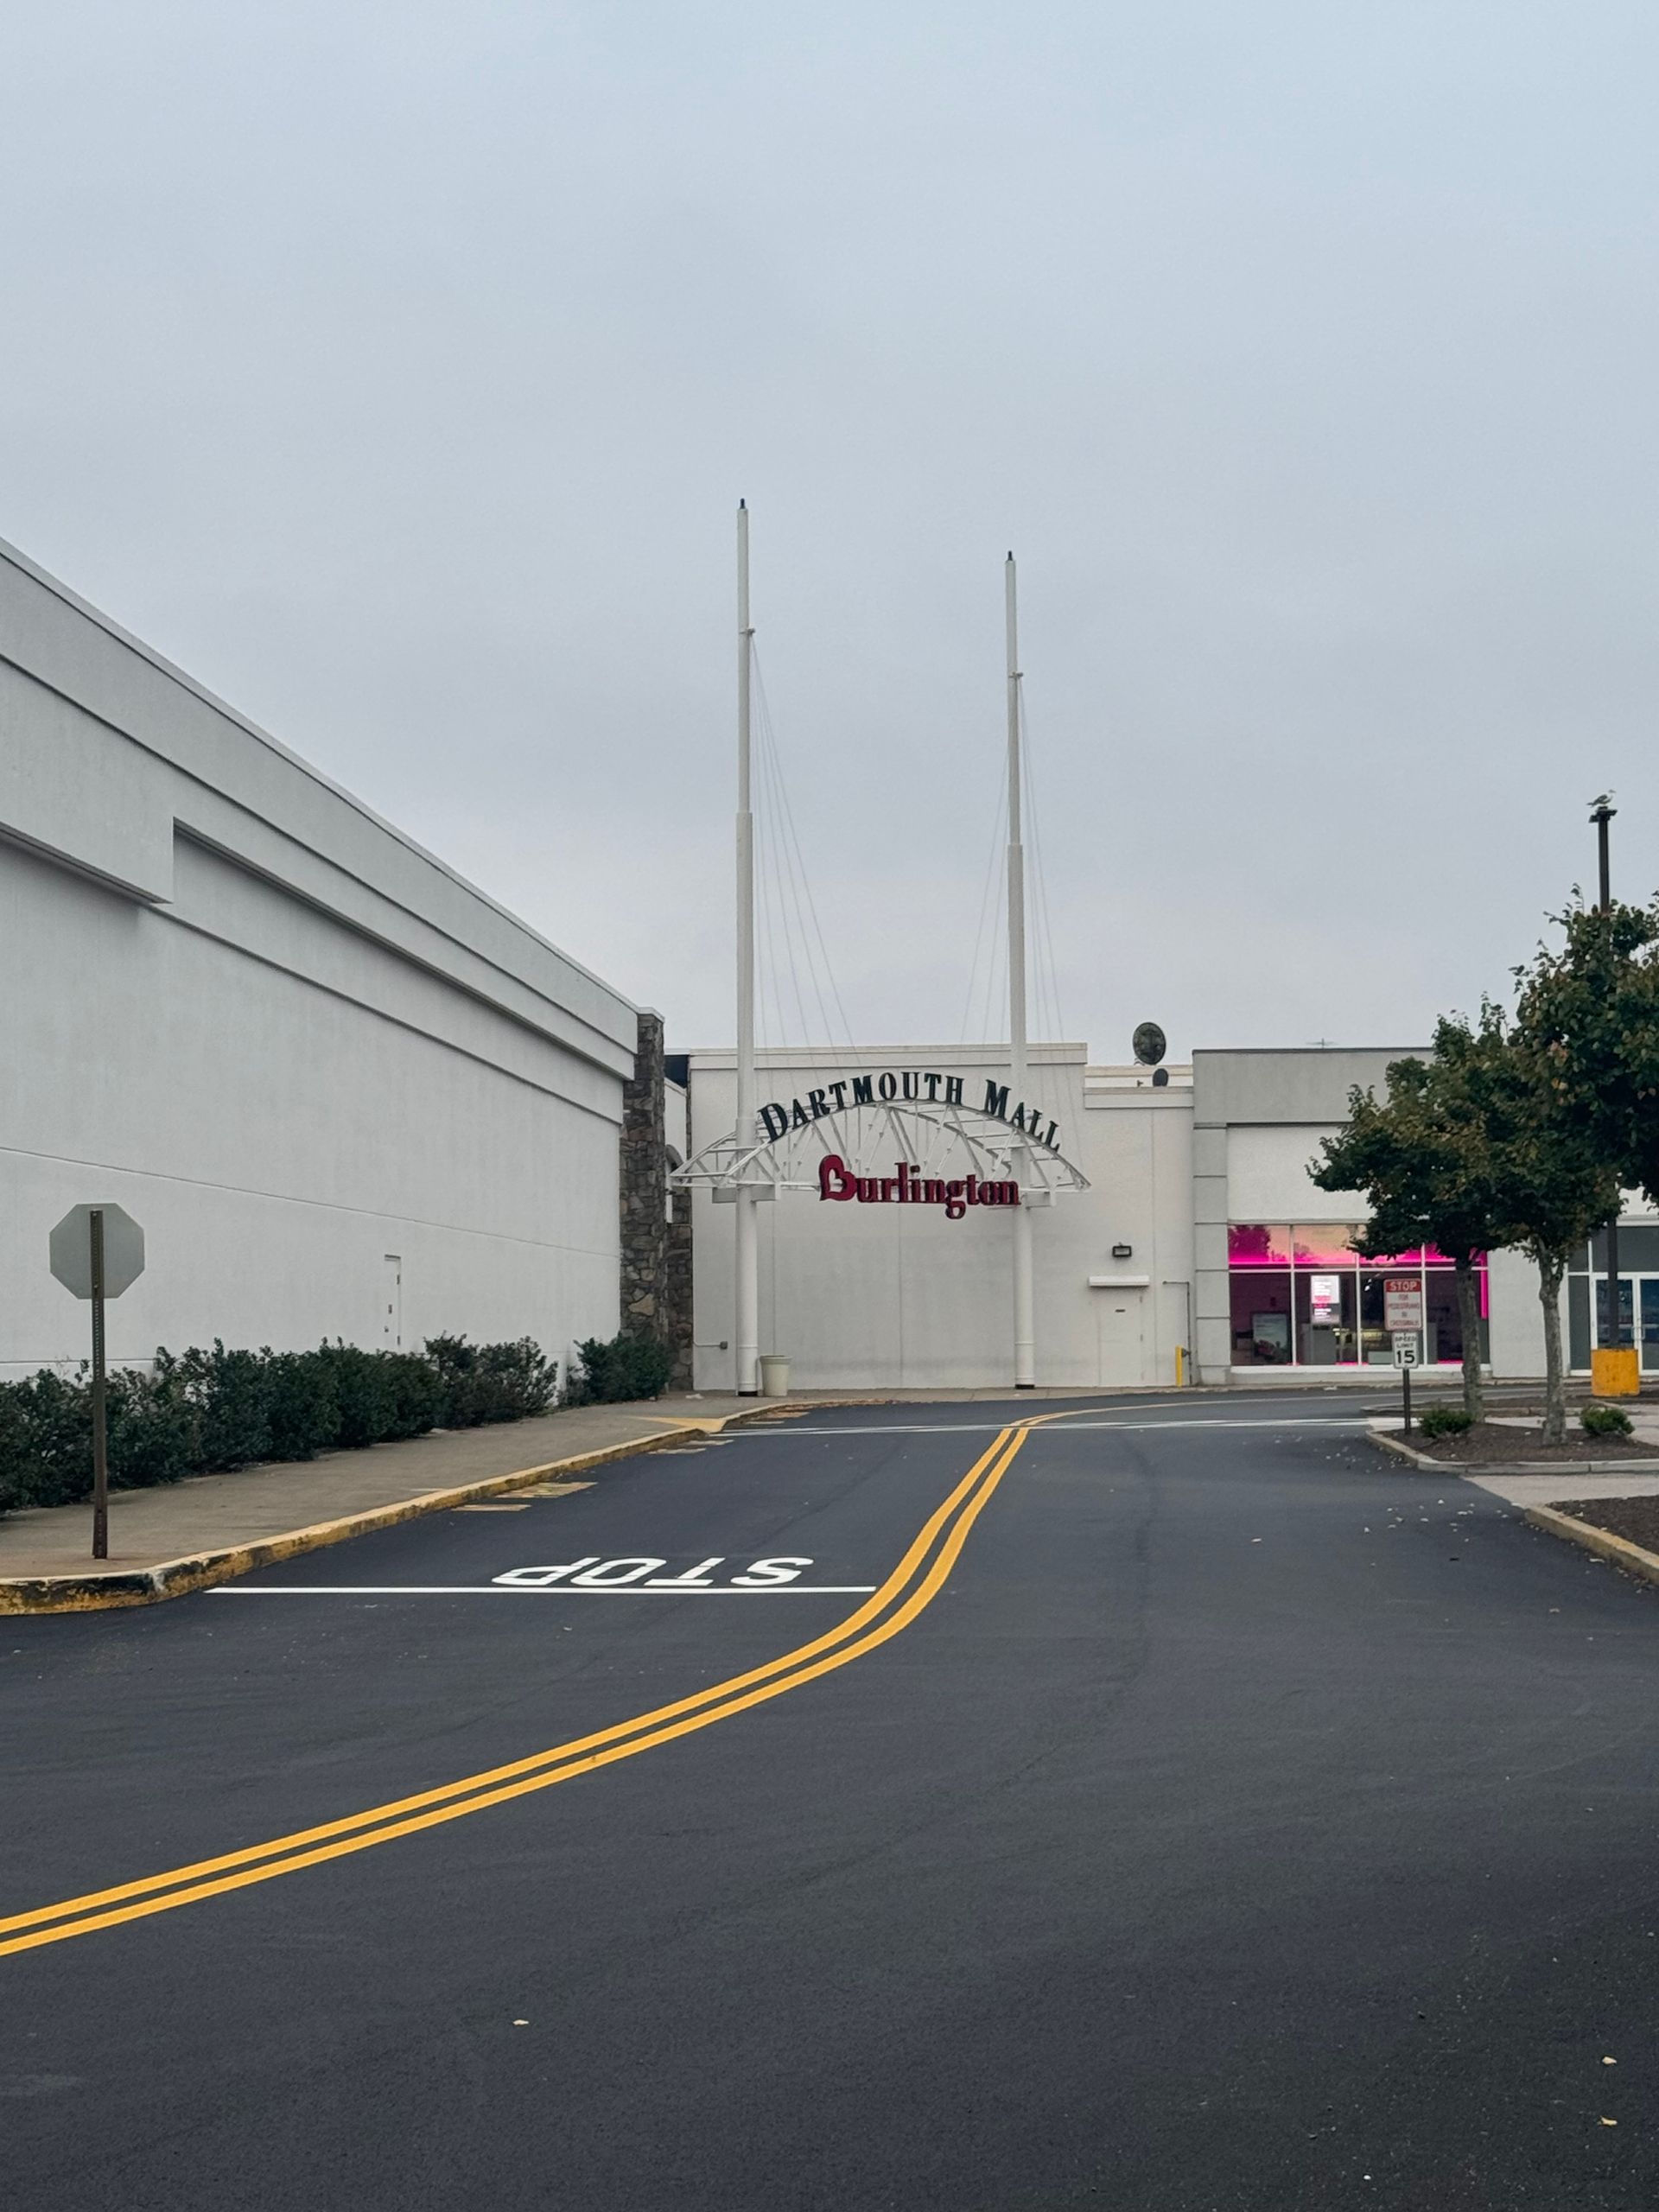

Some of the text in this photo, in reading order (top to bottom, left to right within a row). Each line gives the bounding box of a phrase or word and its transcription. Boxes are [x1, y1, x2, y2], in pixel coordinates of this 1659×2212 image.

[757, 1072, 1061, 1153] DARTMOUTH MALL
[818, 1154, 1021, 1219] Burlington
[1389, 1281, 1417, 1291] STOP
[1396, 1351, 1414, 1363] 15
[492, 1557, 814, 1586] STOP
